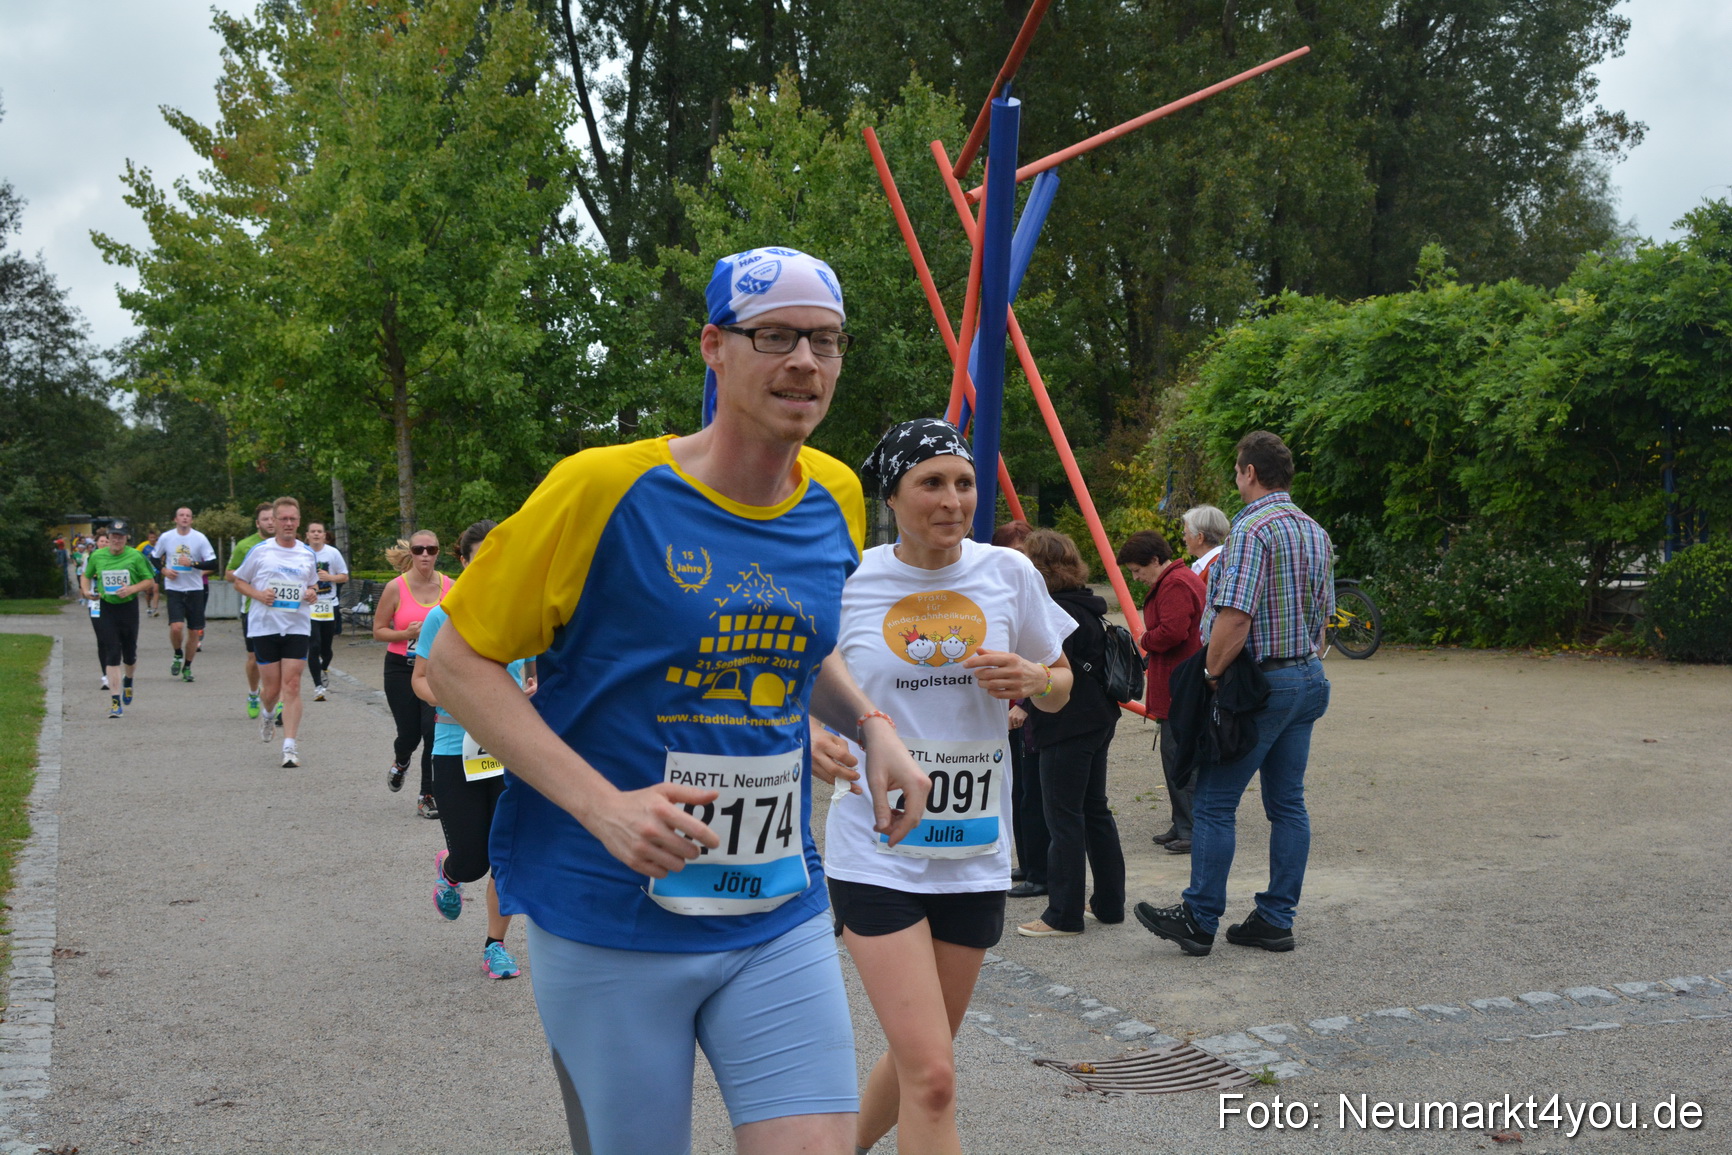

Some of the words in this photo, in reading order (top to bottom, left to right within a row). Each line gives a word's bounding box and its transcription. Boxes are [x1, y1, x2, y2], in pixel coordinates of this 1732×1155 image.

[738, 256, 762, 268] HAD
[682, 551, 694, 560] 15
[677, 563, 703, 574] Jahre
[105, 576, 128, 585] 3364
[272, 587, 300, 600] 2438
[926, 603, 942, 611] für
[771, 656, 800, 669] 2014
[896, 674, 973, 691] Ingolstadt
[936, 752, 989, 764] Neumarkt
[481, 760, 504, 770] Clau
[670, 769, 729, 788] PARTL
[733, 769, 791, 788] Neumarkt
[896, 769, 992, 814] 091
[924, 825, 964, 843] Julia
[713, 871, 762, 898] Jörg
